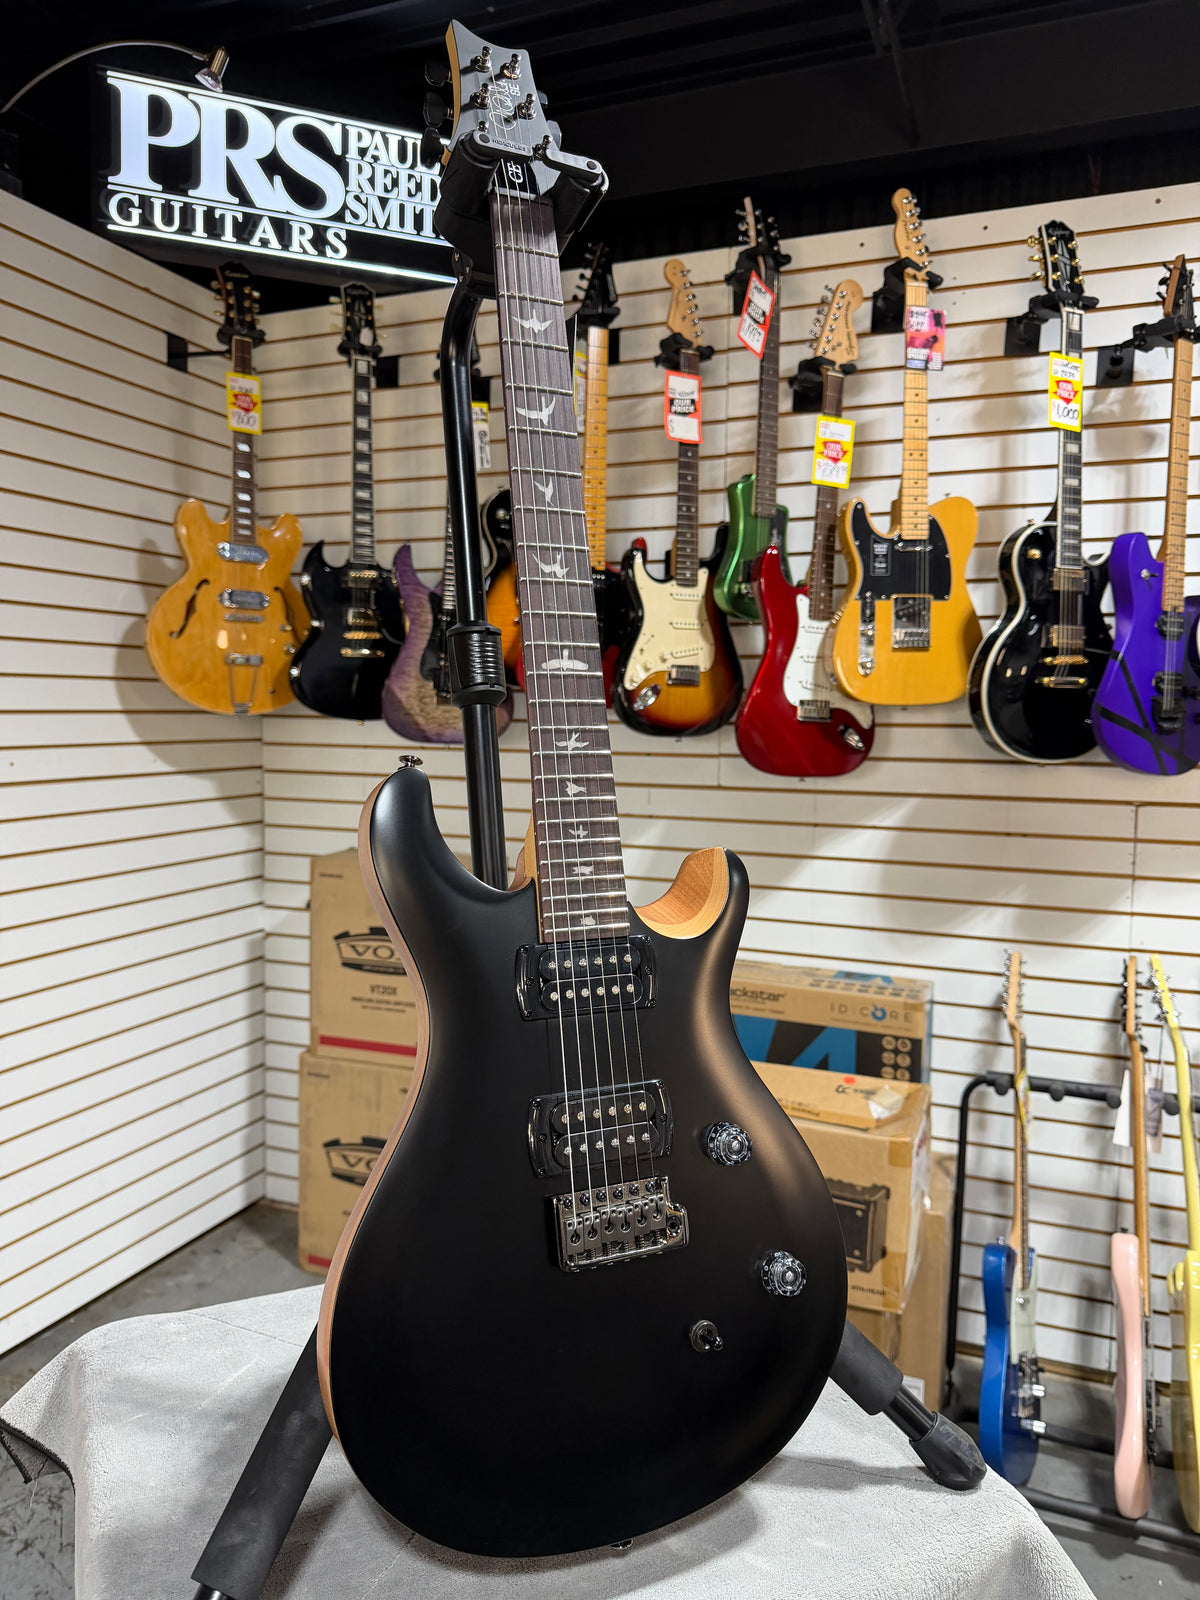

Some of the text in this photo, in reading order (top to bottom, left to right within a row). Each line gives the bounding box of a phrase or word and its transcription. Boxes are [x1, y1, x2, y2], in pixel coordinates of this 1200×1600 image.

[107, 77, 345, 219] PRS
[345, 125, 441, 175] PAUL
[345, 159, 441, 207] REED
[108, 193, 348, 260] GUITARS
[345, 191, 445, 240] SMIT
[349, 943, 401, 961] VO
